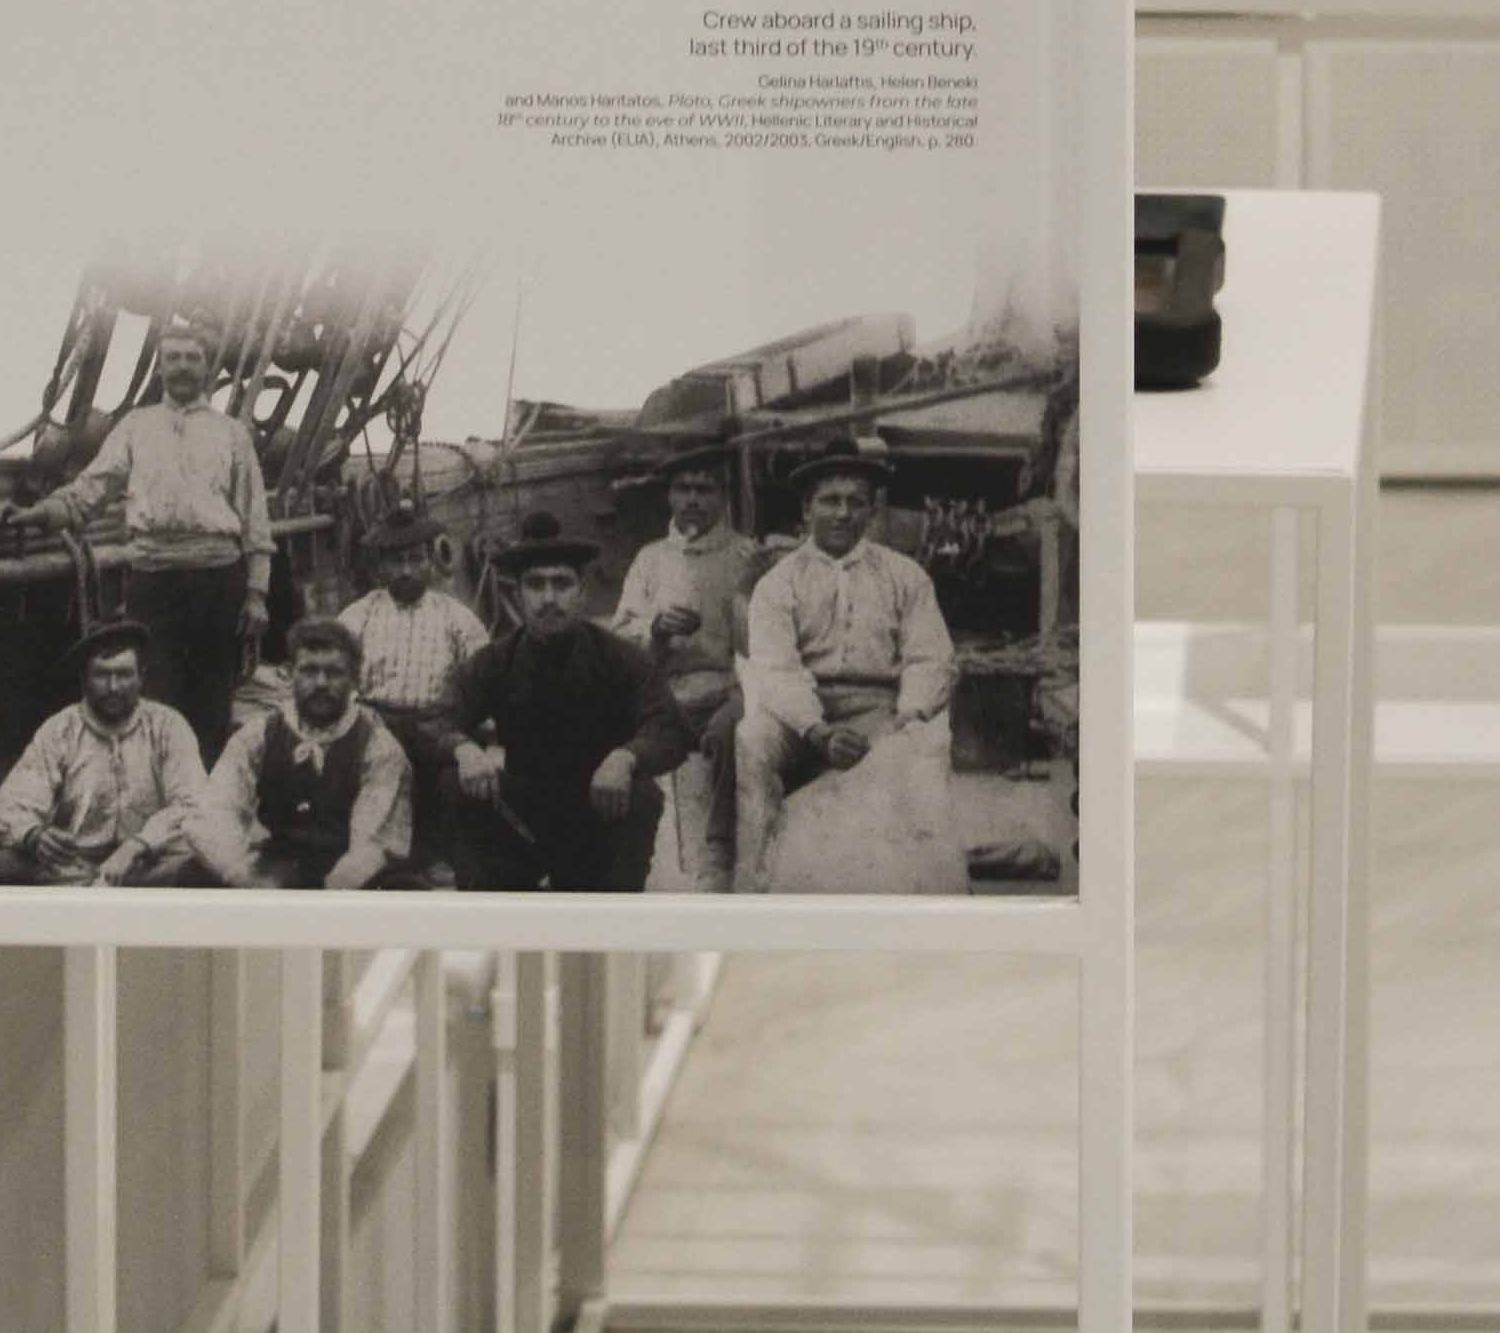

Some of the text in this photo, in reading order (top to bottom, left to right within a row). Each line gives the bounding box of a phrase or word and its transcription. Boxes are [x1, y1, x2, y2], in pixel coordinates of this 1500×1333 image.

[703, 11, 757, 29] Crew
[762, 12, 834, 29] aboard
[840, 15, 852, 29] a
[857, 11, 923, 35] sailing
[690, 38, 726, 56] last
[734, 39, 781, 56] third
[786, 38, 807, 57] of
[813, 39, 848, 56] the
